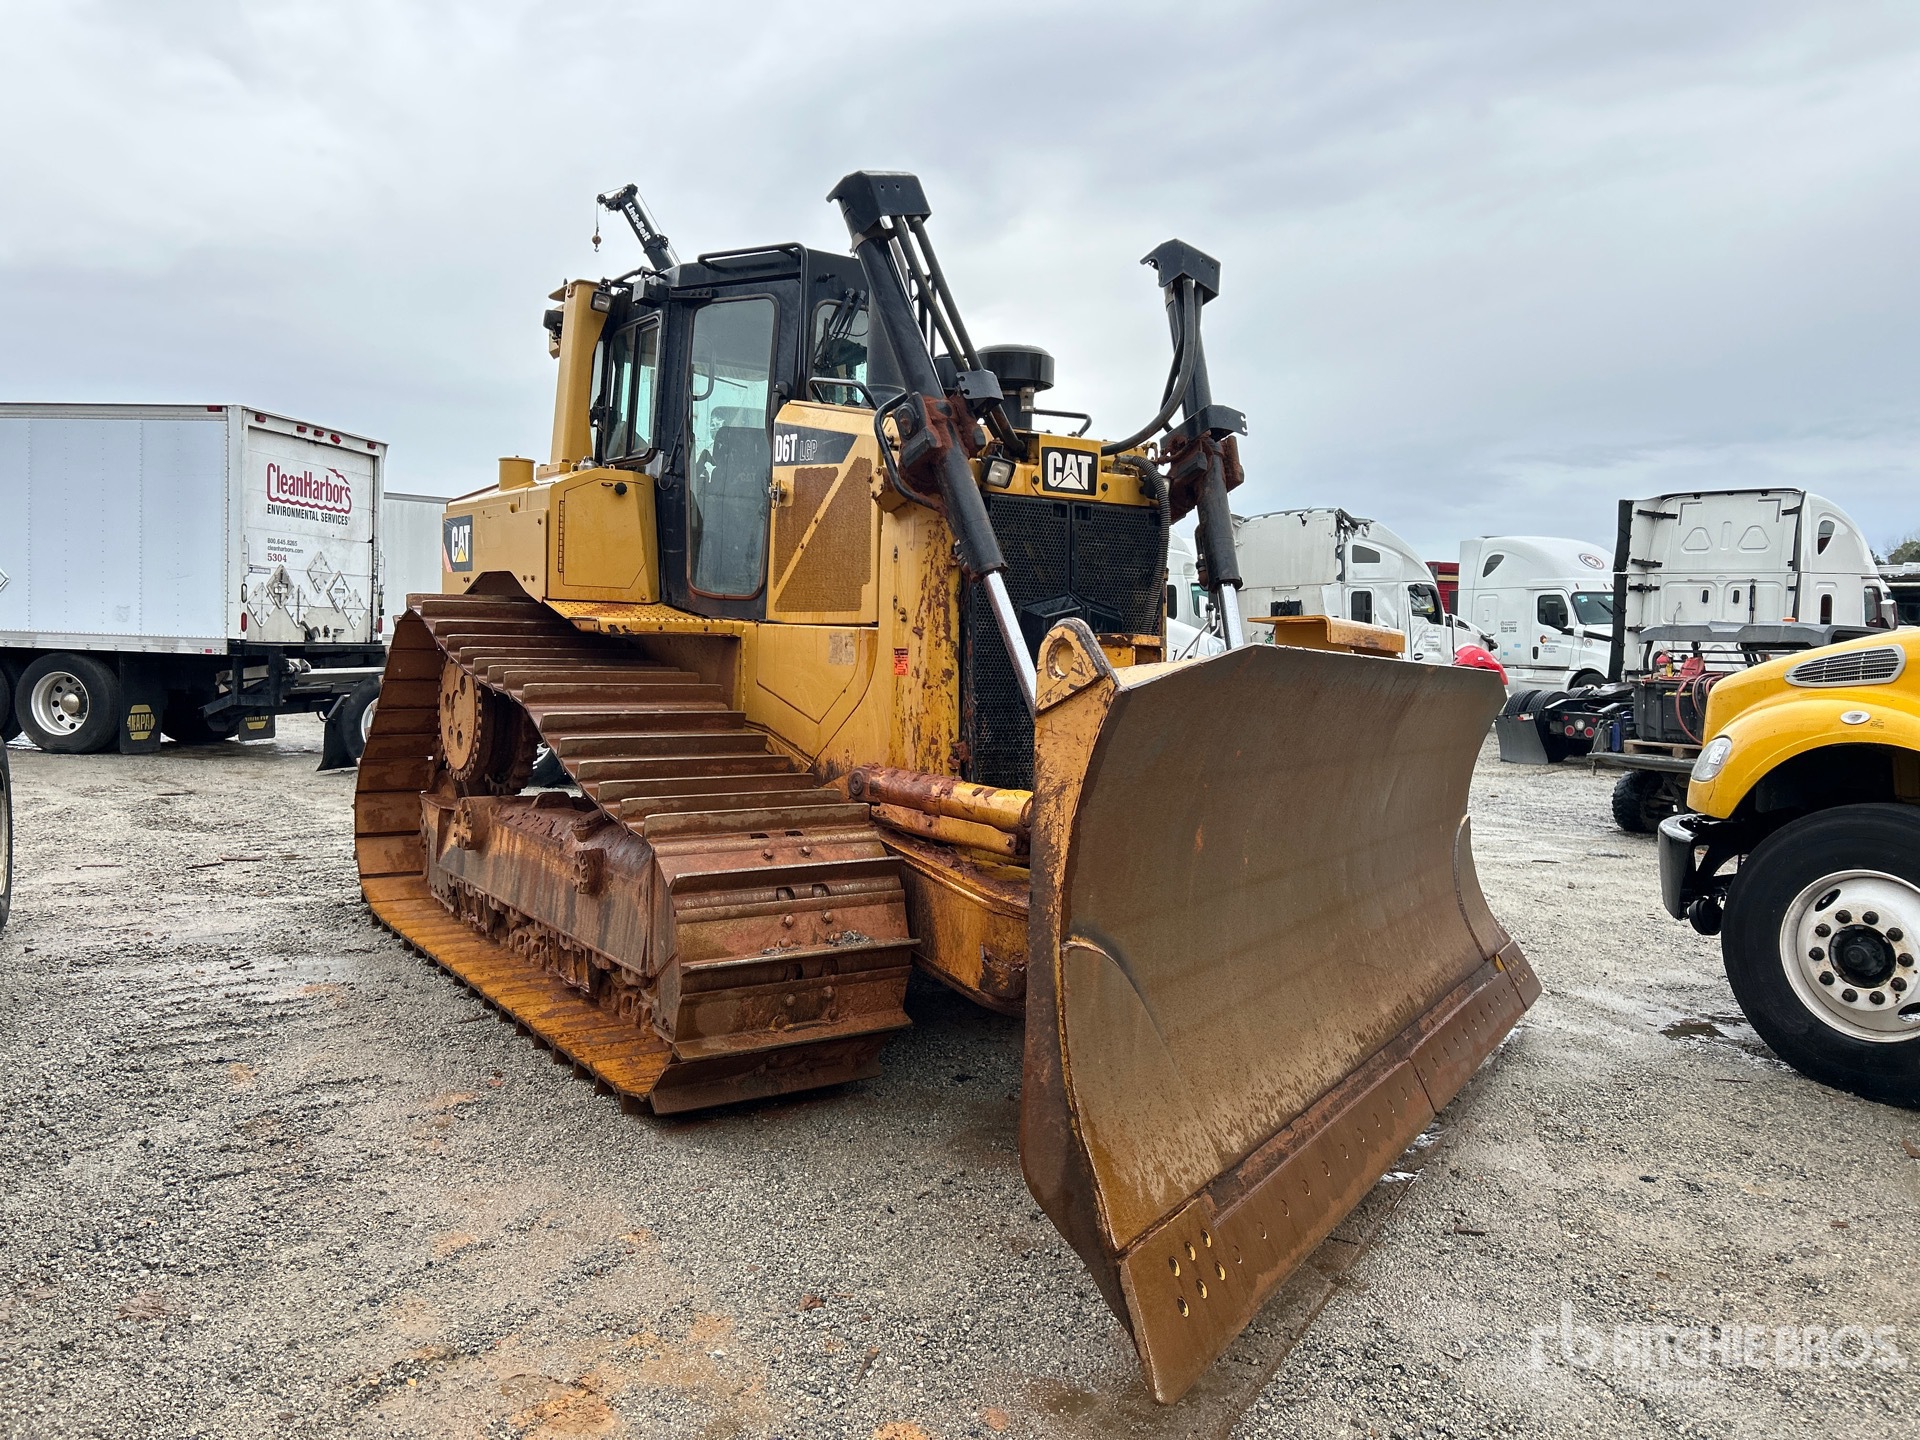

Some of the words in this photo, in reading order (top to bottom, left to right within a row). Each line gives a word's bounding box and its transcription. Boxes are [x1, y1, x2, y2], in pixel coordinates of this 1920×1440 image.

[625, 201, 651, 242] Link-Belt
[775, 433, 798, 463] D6T
[800, 439, 818, 462] LGP
[1047, 451, 1093, 491] CAT
[267, 503, 319, 522] ENVIRONMENTAL
[320, 512, 349, 526] SERVICES
[267, 544, 304, 554] cleanharbors.com
[267, 552, 288, 563] 5304
[451, 524, 471, 563] CAT
